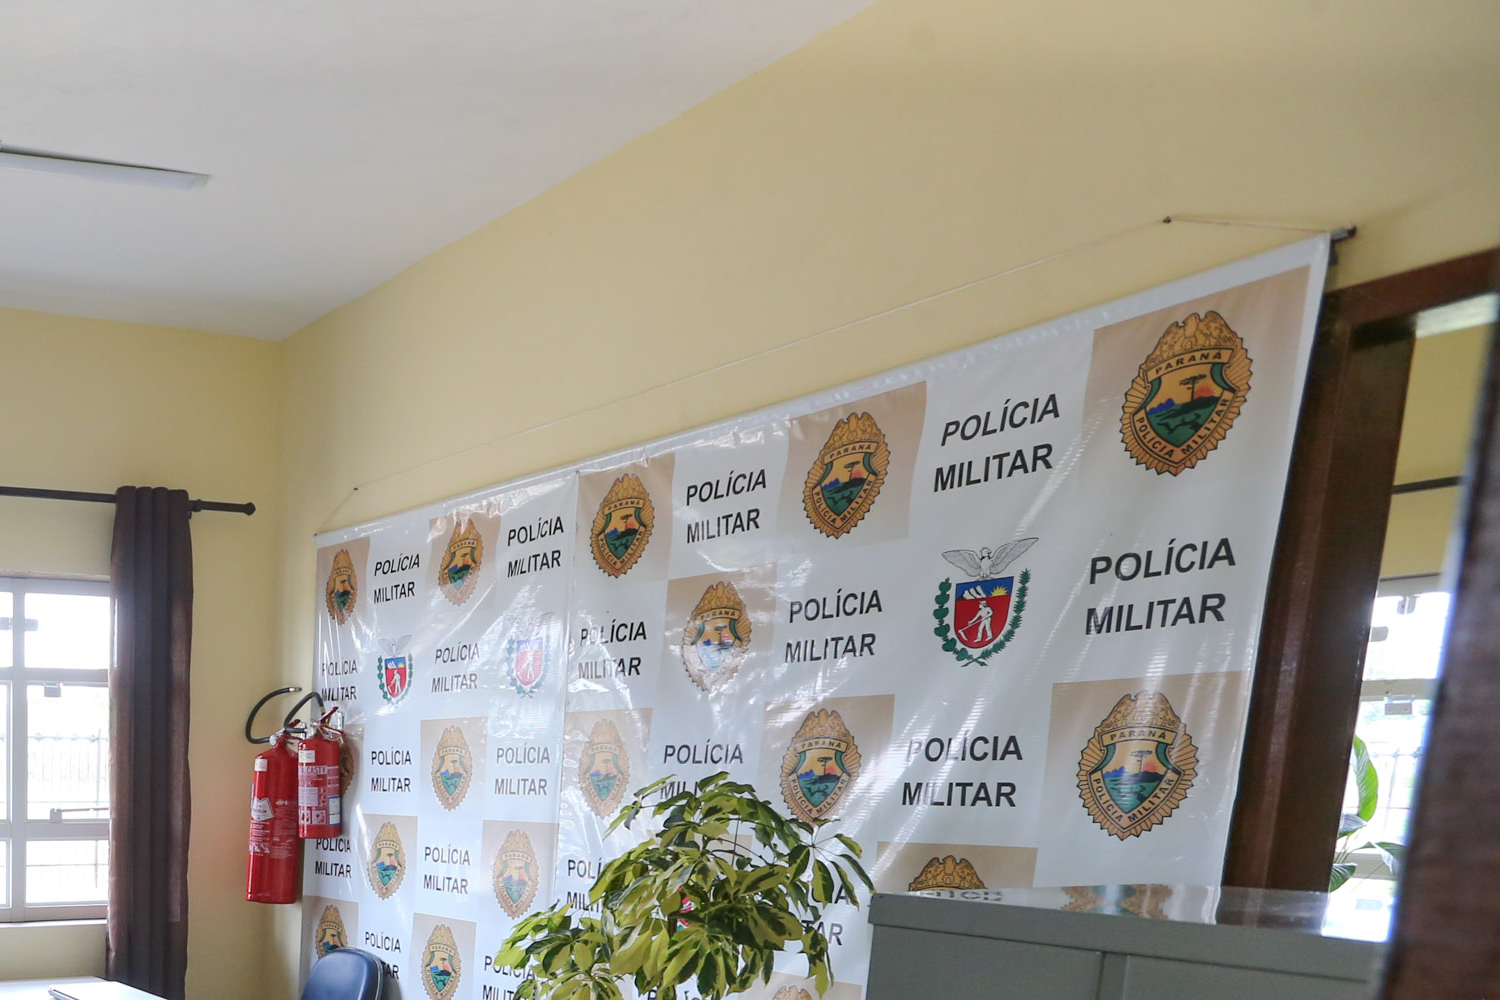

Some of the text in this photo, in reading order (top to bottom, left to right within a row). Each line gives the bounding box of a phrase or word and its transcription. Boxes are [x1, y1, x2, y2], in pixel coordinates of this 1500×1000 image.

[1155, 350, 1224, 376] PARANÁ
[941, 393, 1060, 447] POLÍCIA
[1181, 396, 1230, 455] MILITAR
[933, 443, 1053, 493] MILITAR
[686, 469, 767, 506] POLÍCIA
[840, 478, 874, 523] MILITAR
[507, 516, 564, 547] POLÍCIA
[686, 508, 760, 544] MILITAR
[374, 553, 420, 576] POLÍCIA
[507, 549, 561, 578] MILITAR
[1089, 537, 1236, 585] POLÍCIA
[374, 581, 416, 604] MILITAR
[789, 588, 883, 624] POLÍCIA
[1084, 593, 1227, 635] MILITAR
[434, 641, 480, 664] POLÍCIA
[784, 633, 877, 664] MILITAR
[578, 656, 642, 680] MILITAR
[431, 673, 478, 694] MILITAR
[371, 746, 412, 766] POLÍCIA
[496, 742, 550, 764] POLÍCIA
[663, 739, 744, 765] POLÍCIA
[907, 730, 1023, 762] POLÍCIA
[371, 777, 411, 793] MILITAR
[494, 778, 548, 796] MILITAR
[902, 782, 1017, 807] MILITAR
[1127, 775, 1175, 824] MILITAR
[424, 843, 470, 866] POLÍCIA
[315, 861, 351, 878] MILITAR
[567, 857, 603, 880] POLÍ
[423, 875, 469, 895] MILITAR
[365, 931, 401, 952] POLÍCIA
